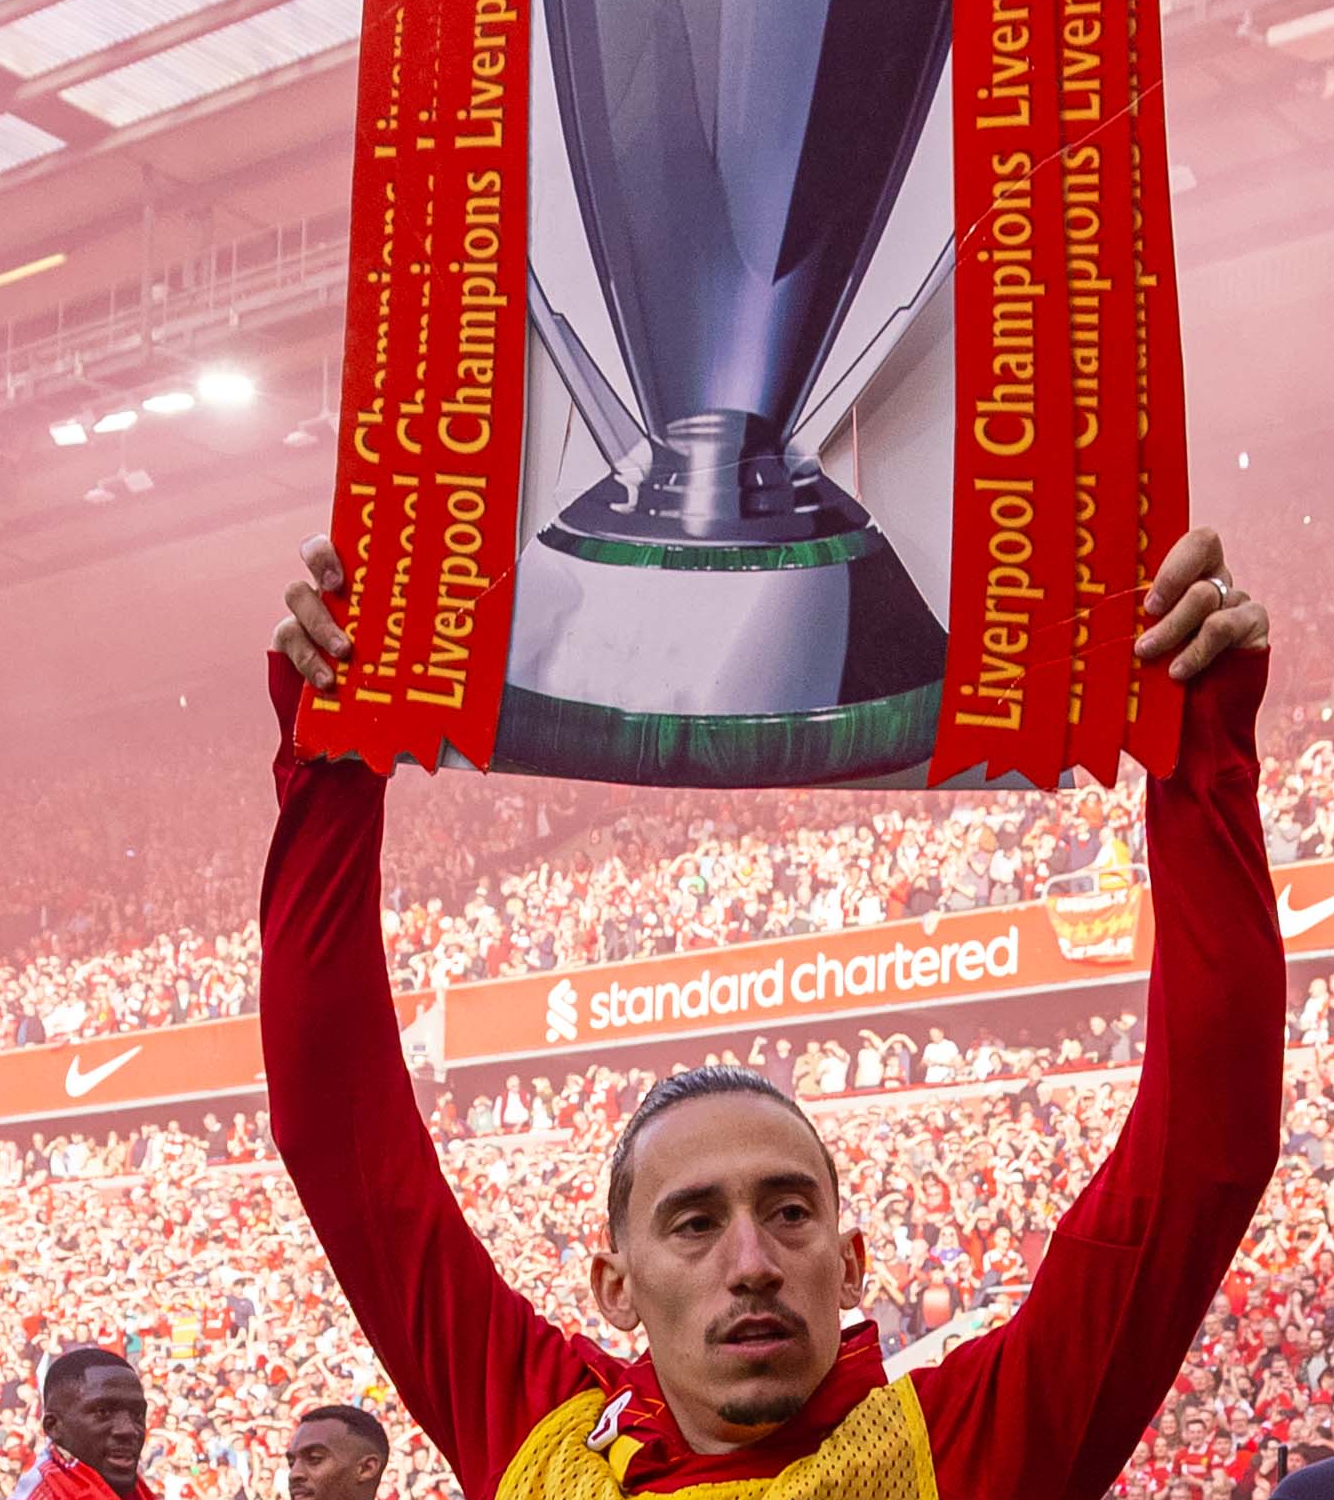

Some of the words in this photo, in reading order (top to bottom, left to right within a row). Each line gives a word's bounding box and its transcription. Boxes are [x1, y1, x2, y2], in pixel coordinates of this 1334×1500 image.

[437, 170, 508, 454] Champions
[973, 151, 1046, 456] Champions
[406, 472, 491, 709] Liverpool
[955, 478, 1044, 730] Liverpool
[589, 958, 784, 1029] standard
[790, 925, 1020, 1002] chartered
